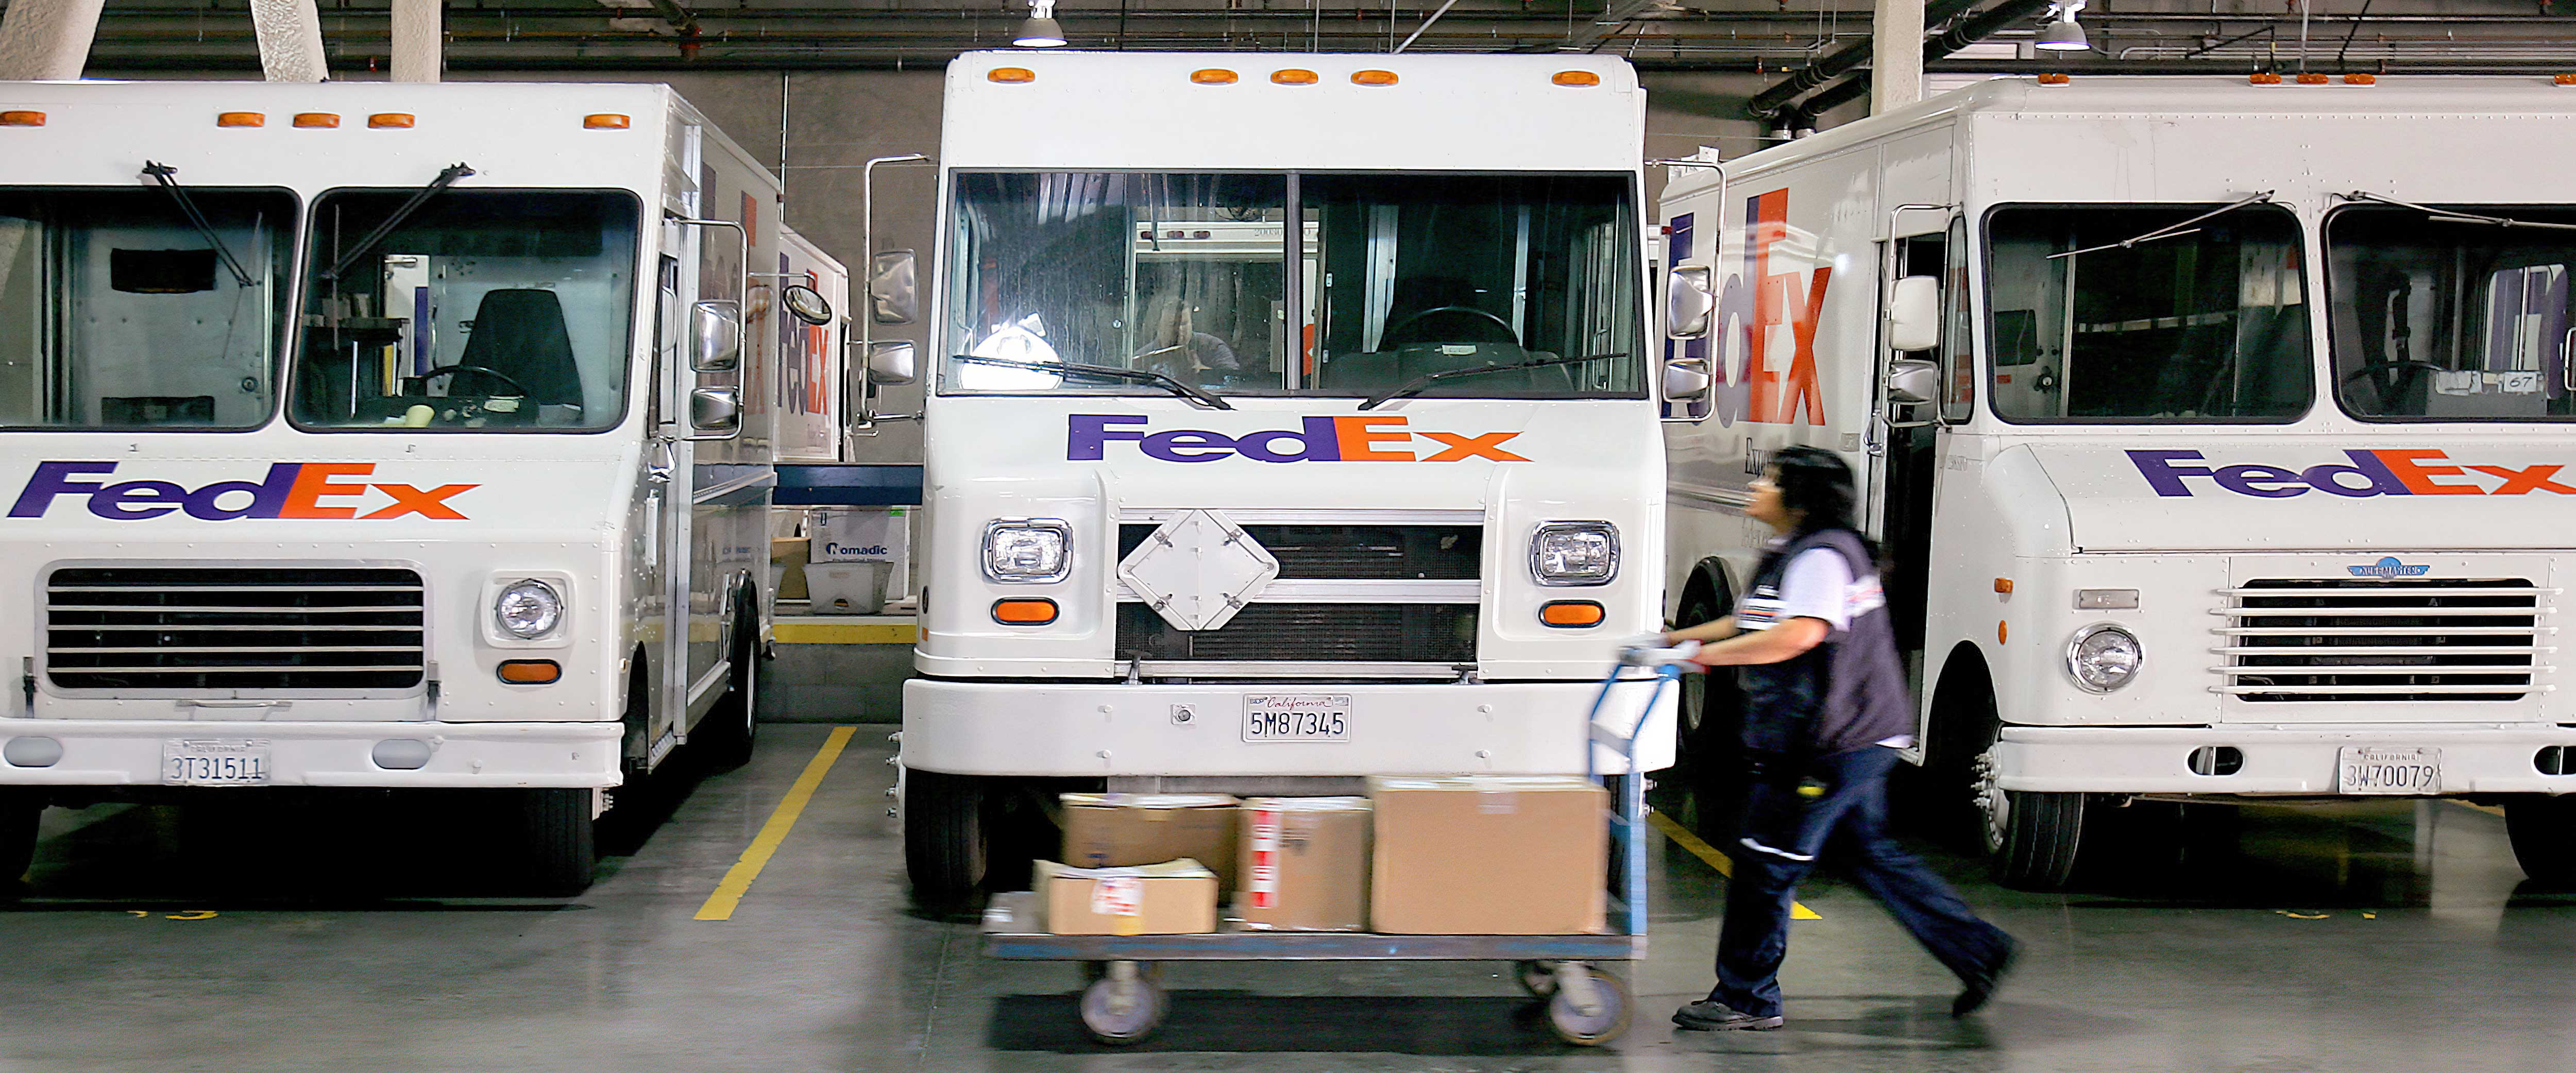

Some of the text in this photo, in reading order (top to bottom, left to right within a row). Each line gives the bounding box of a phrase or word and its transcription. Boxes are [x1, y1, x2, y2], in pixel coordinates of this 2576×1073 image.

[2510, 377, 2532, 387] 67
[1067, 414, 1534, 463] FedEx
[2124, 449, 2576, 497] FedEx
[7, 461, 483, 520] FedEx
[826, 542, 888, 555] Nomadic
[1267, 697, 1333, 710] California
[1251, 712, 1344, 735] 5M87345
[171, 758, 262, 779] 3T31511
[2348, 765, 2434, 787] 3W70079
